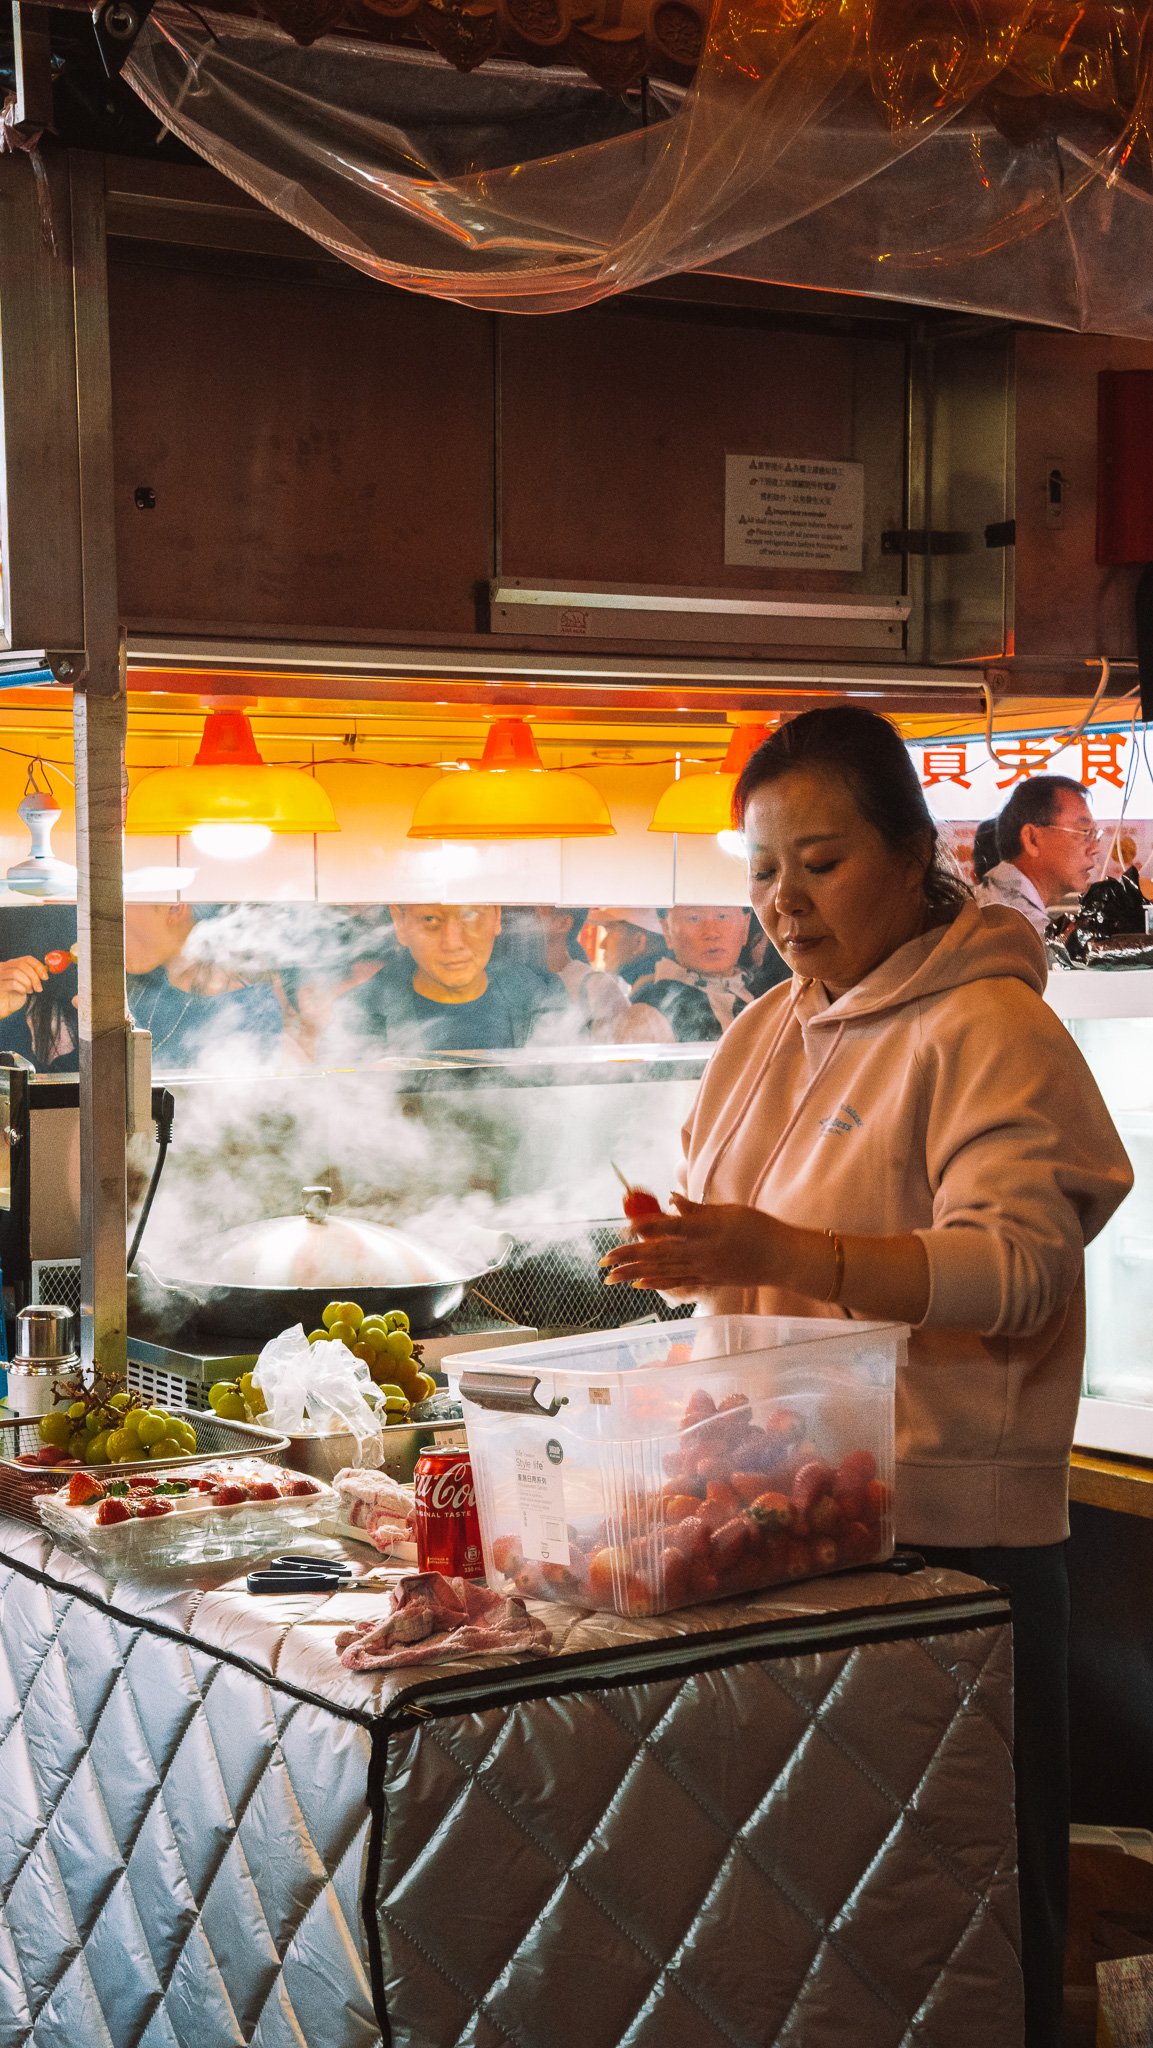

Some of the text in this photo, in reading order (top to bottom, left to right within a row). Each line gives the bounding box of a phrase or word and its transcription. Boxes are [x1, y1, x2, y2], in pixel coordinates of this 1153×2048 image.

[773, 508, 801, 517] Important
[515, 1457, 544, 1472] Style life
[444, 1510, 472, 1519] TASTE
